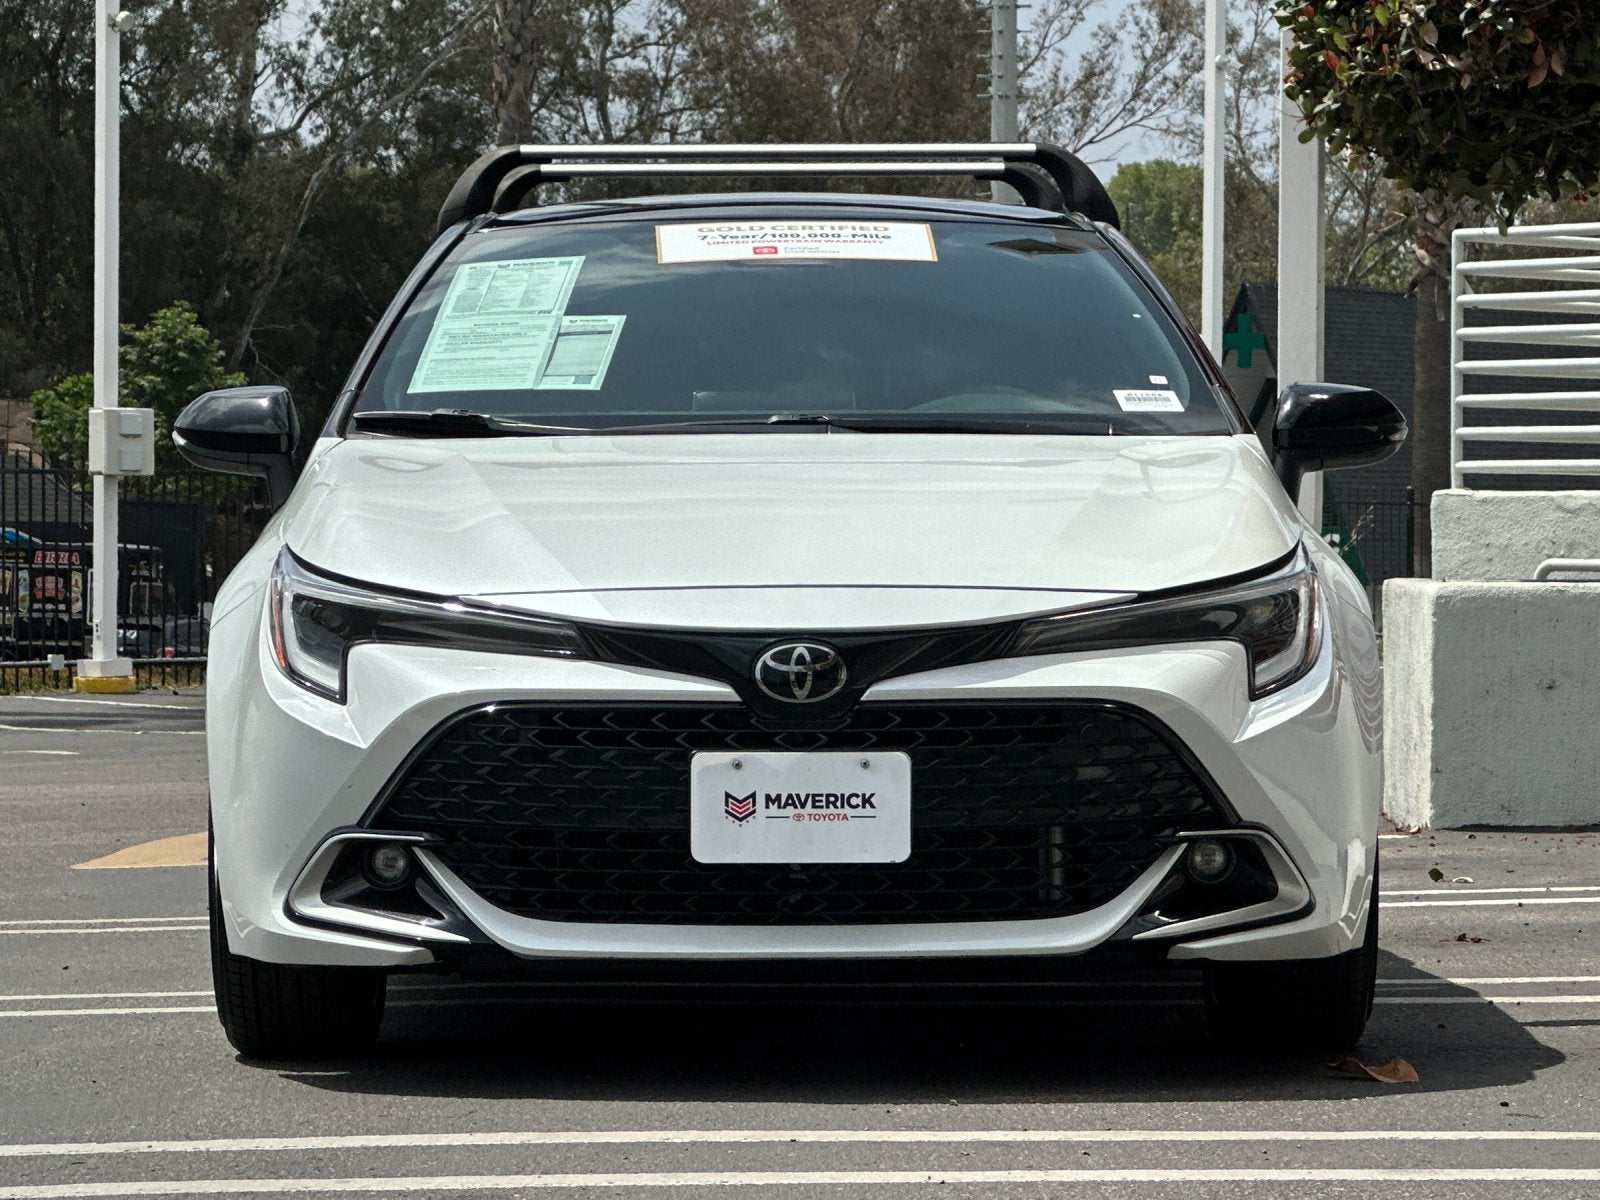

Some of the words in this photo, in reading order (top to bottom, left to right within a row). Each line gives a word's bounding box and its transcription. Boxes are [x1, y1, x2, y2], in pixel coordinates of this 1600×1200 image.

[698, 225, 765, 233] GOLD
[770, 224, 889, 232] CERTIFIED
[764, 792, 877, 810] MAVERICK
[807, 813, 849, 822] TOYOTA
